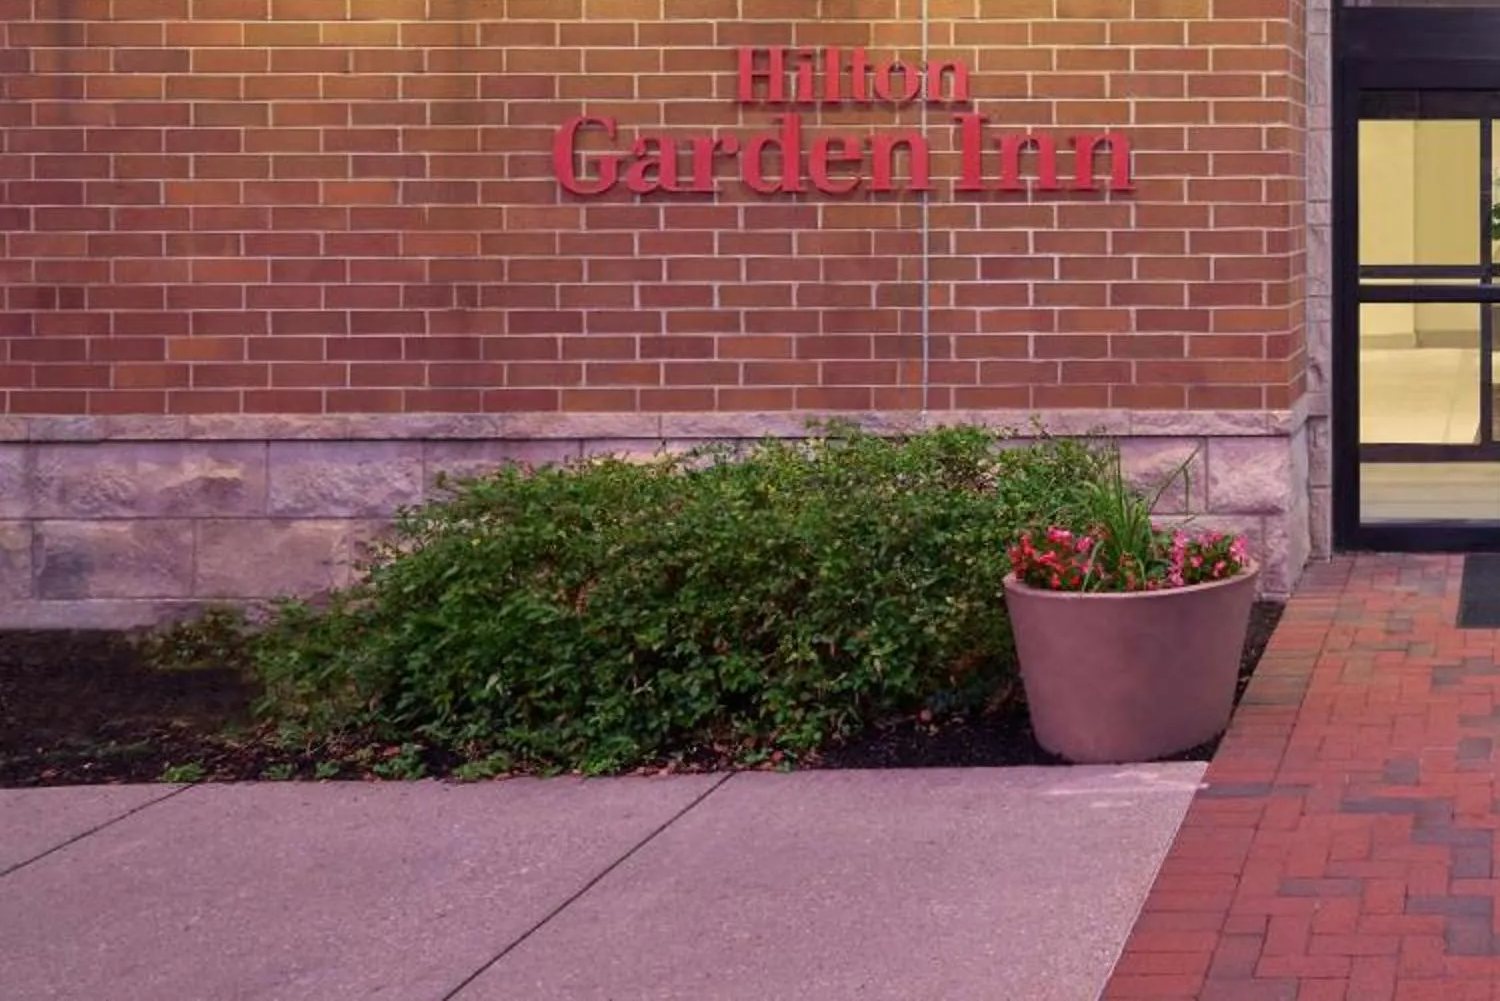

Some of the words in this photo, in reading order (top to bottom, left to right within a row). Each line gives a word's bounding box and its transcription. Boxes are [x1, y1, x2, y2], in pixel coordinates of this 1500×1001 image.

[736, 46, 973, 103] Hilton
[553, 112, 931, 195] Garden
[954, 112, 1135, 193] Inn
